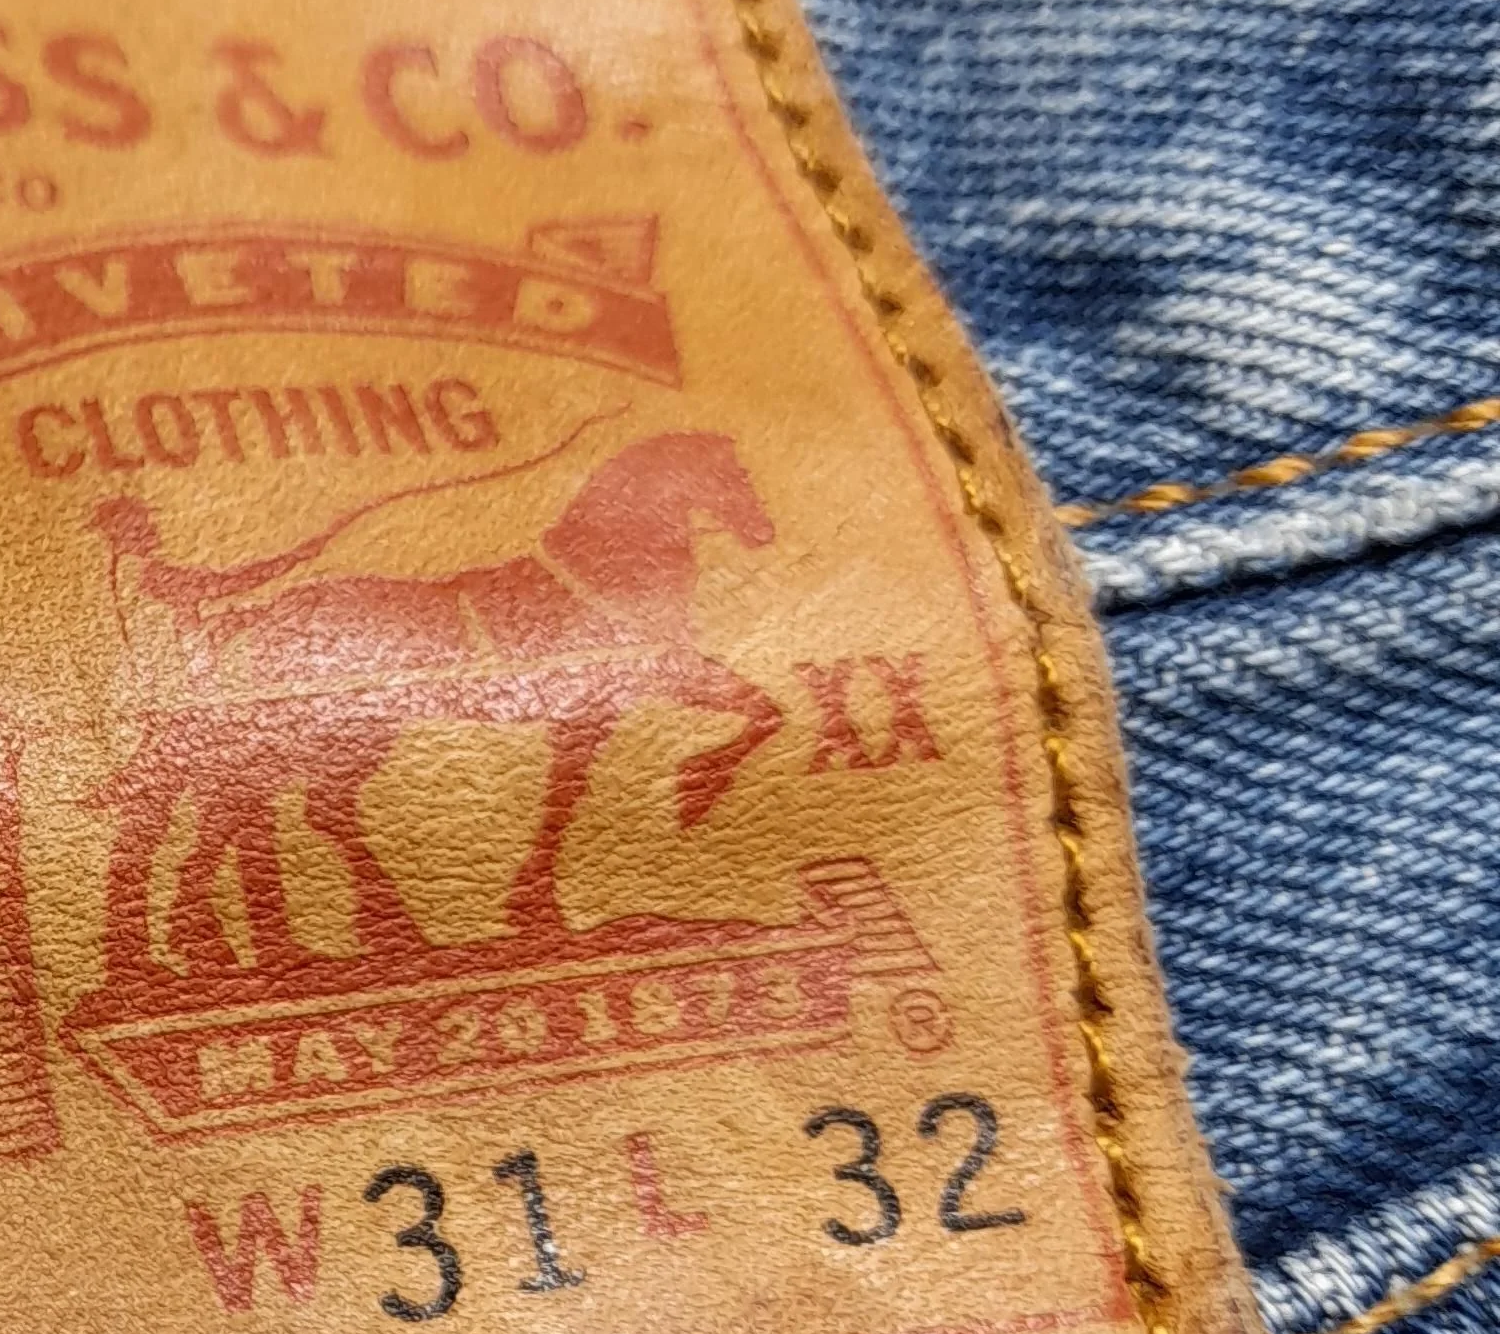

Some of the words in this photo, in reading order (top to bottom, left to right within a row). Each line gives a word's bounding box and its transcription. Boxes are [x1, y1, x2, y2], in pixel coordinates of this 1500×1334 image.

[212, 37, 332, 160] &
[360, 33, 650, 162] CO.
[13, 377, 500, 480] CLOTHING
[794, 651, 944, 774] XX
[198, 1015, 403, 1100] MAY
[435, 993, 548, 1069] 20
[185, 1180, 325, 1314] W
[362, 1147, 587, 1324] 31
[623, 1132, 710, 1239] L
[802, 1091, 1028, 1247] 32
